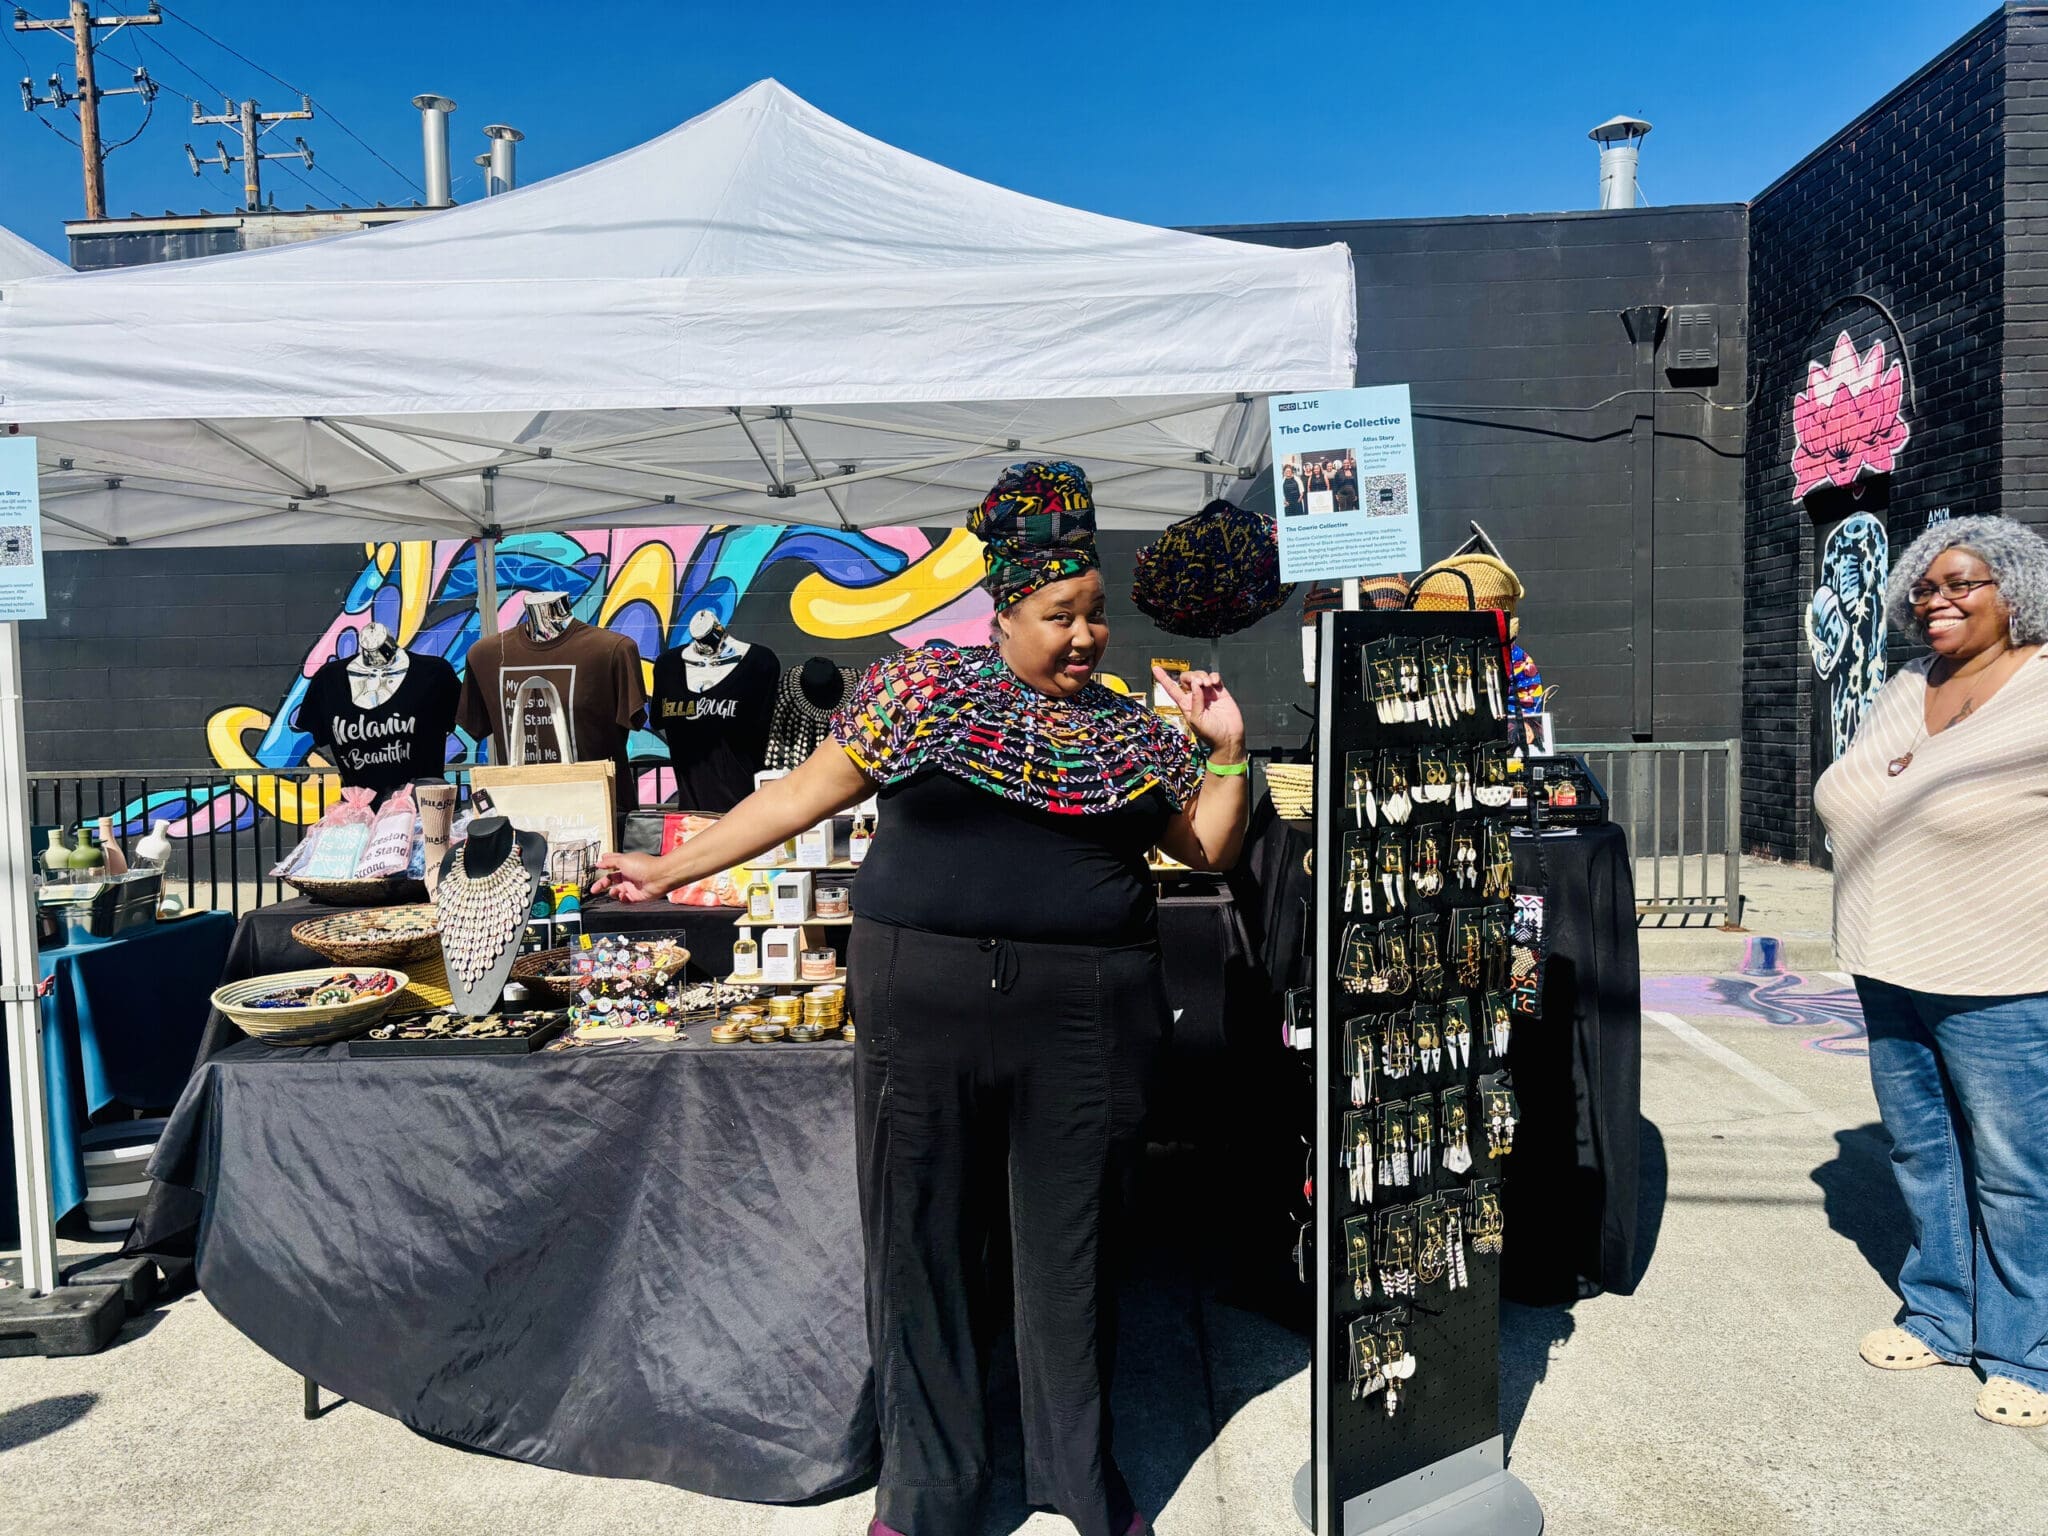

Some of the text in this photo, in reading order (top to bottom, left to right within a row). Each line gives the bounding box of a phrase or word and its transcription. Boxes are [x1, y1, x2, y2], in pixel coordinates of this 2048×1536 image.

[1297, 400, 1319, 410] LIVE
[1279, 416, 1401, 435] The Cowrie Collective
[506, 680, 519, 694] My
[545, 748, 558, 761] Me
